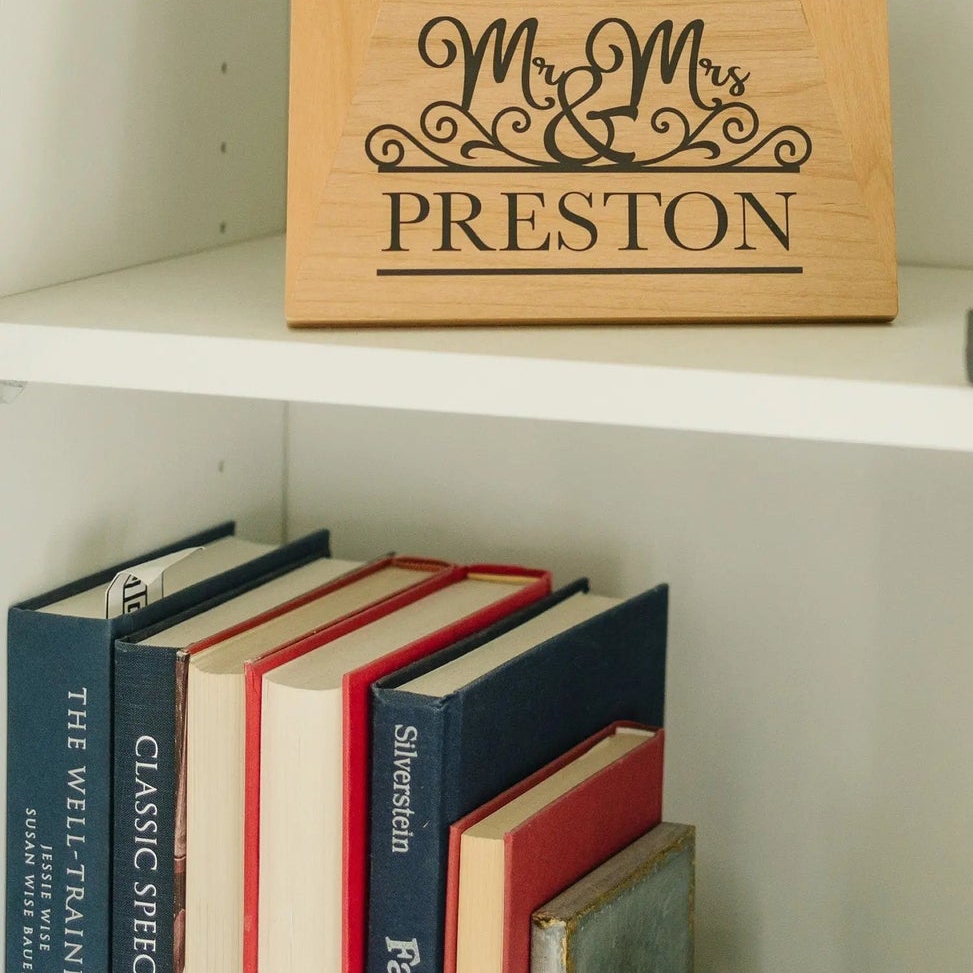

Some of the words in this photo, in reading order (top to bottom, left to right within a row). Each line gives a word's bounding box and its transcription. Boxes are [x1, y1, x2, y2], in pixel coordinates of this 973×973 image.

[418, 15, 566, 113] Mr
[586, 17, 750, 113] Mrs
[380, 190, 797, 253] PRESTON
[67, 687, 88, 750] THE
[134, 735, 159, 871] CLASSIC
[391, 724, 418, 853] Silverstein
[24, 808, 37, 865] SUSAN
[23, 874, 36, 917] WISE
[40, 844, 53, 900] JESSIE
[22, 926, 34, 973] BAUE
[39, 908, 52, 951] WISE
[132, 881, 157, 973] SPEEC
